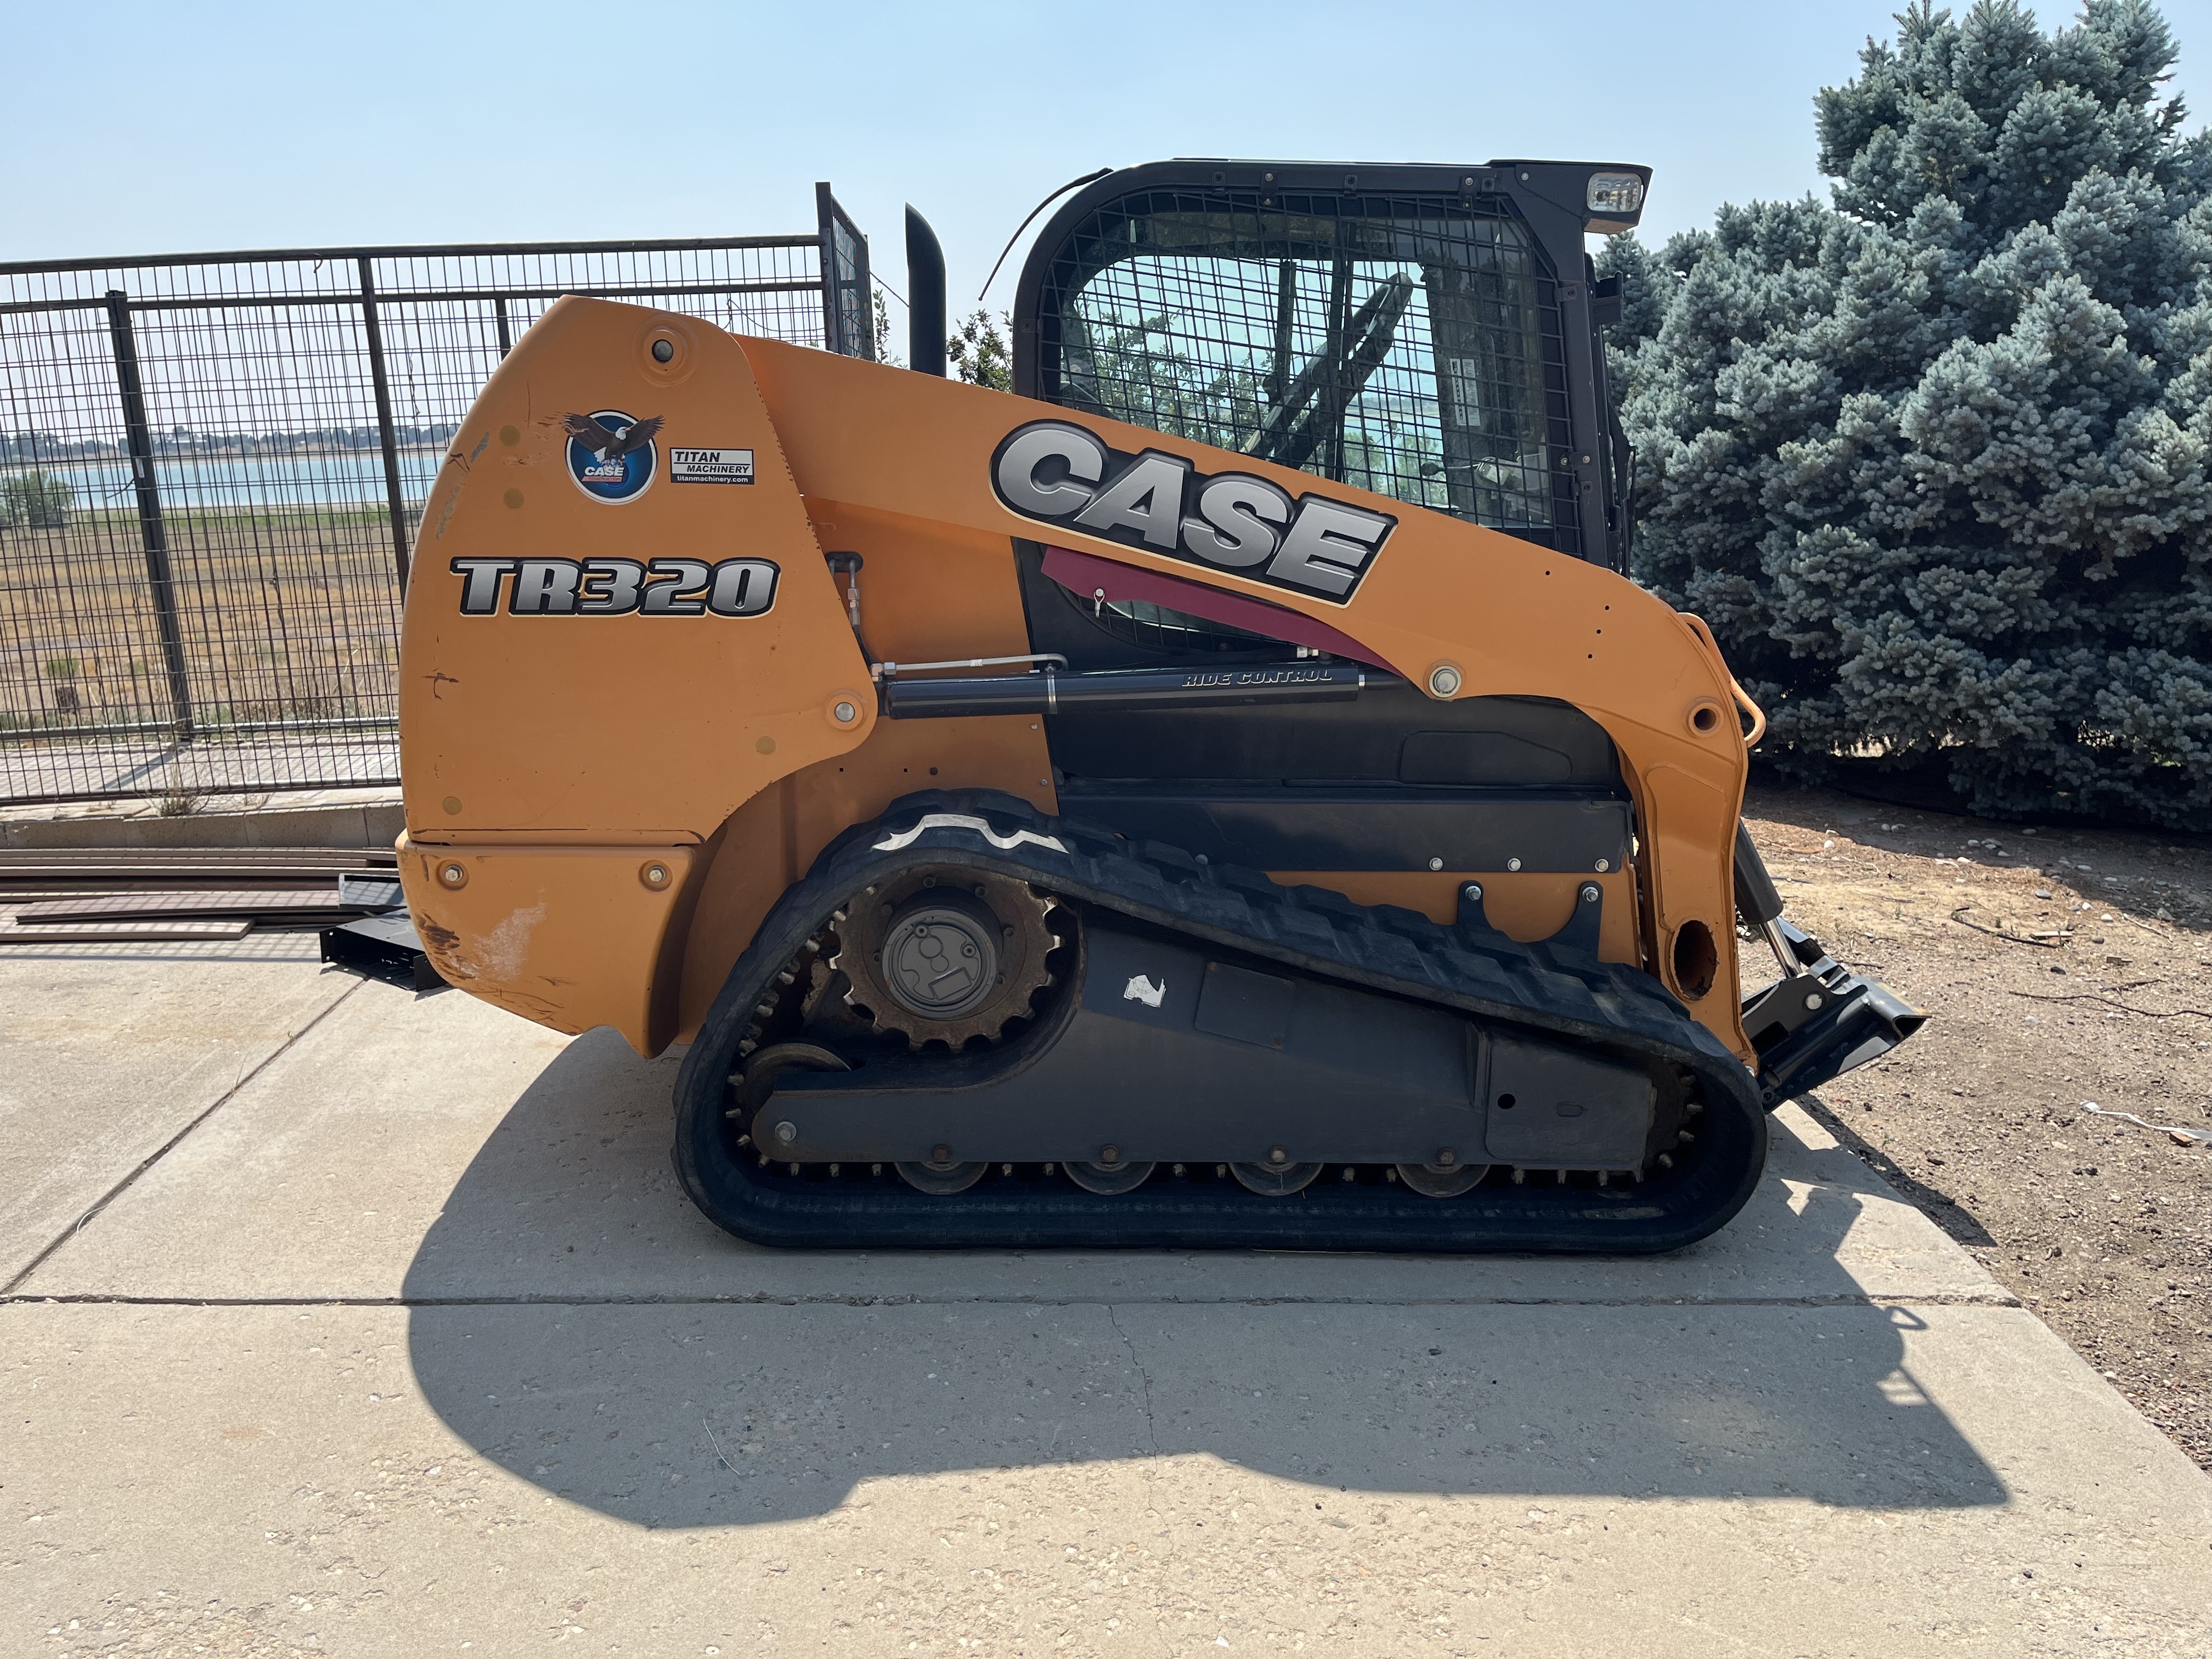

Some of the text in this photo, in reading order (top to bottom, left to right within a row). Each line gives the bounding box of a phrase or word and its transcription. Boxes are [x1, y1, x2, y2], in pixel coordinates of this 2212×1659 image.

[675, 450, 720, 462] TITAN
[584, 466, 625, 476] CASE
[686, 465, 749, 473] MACHINERY
[676, 475, 748, 483] titanmachinery.com
[997, 427, 1388, 597] CASE
[453, 558, 780, 615] TR320
[1182, 669, 1333, 687] RIDE CONTROL
